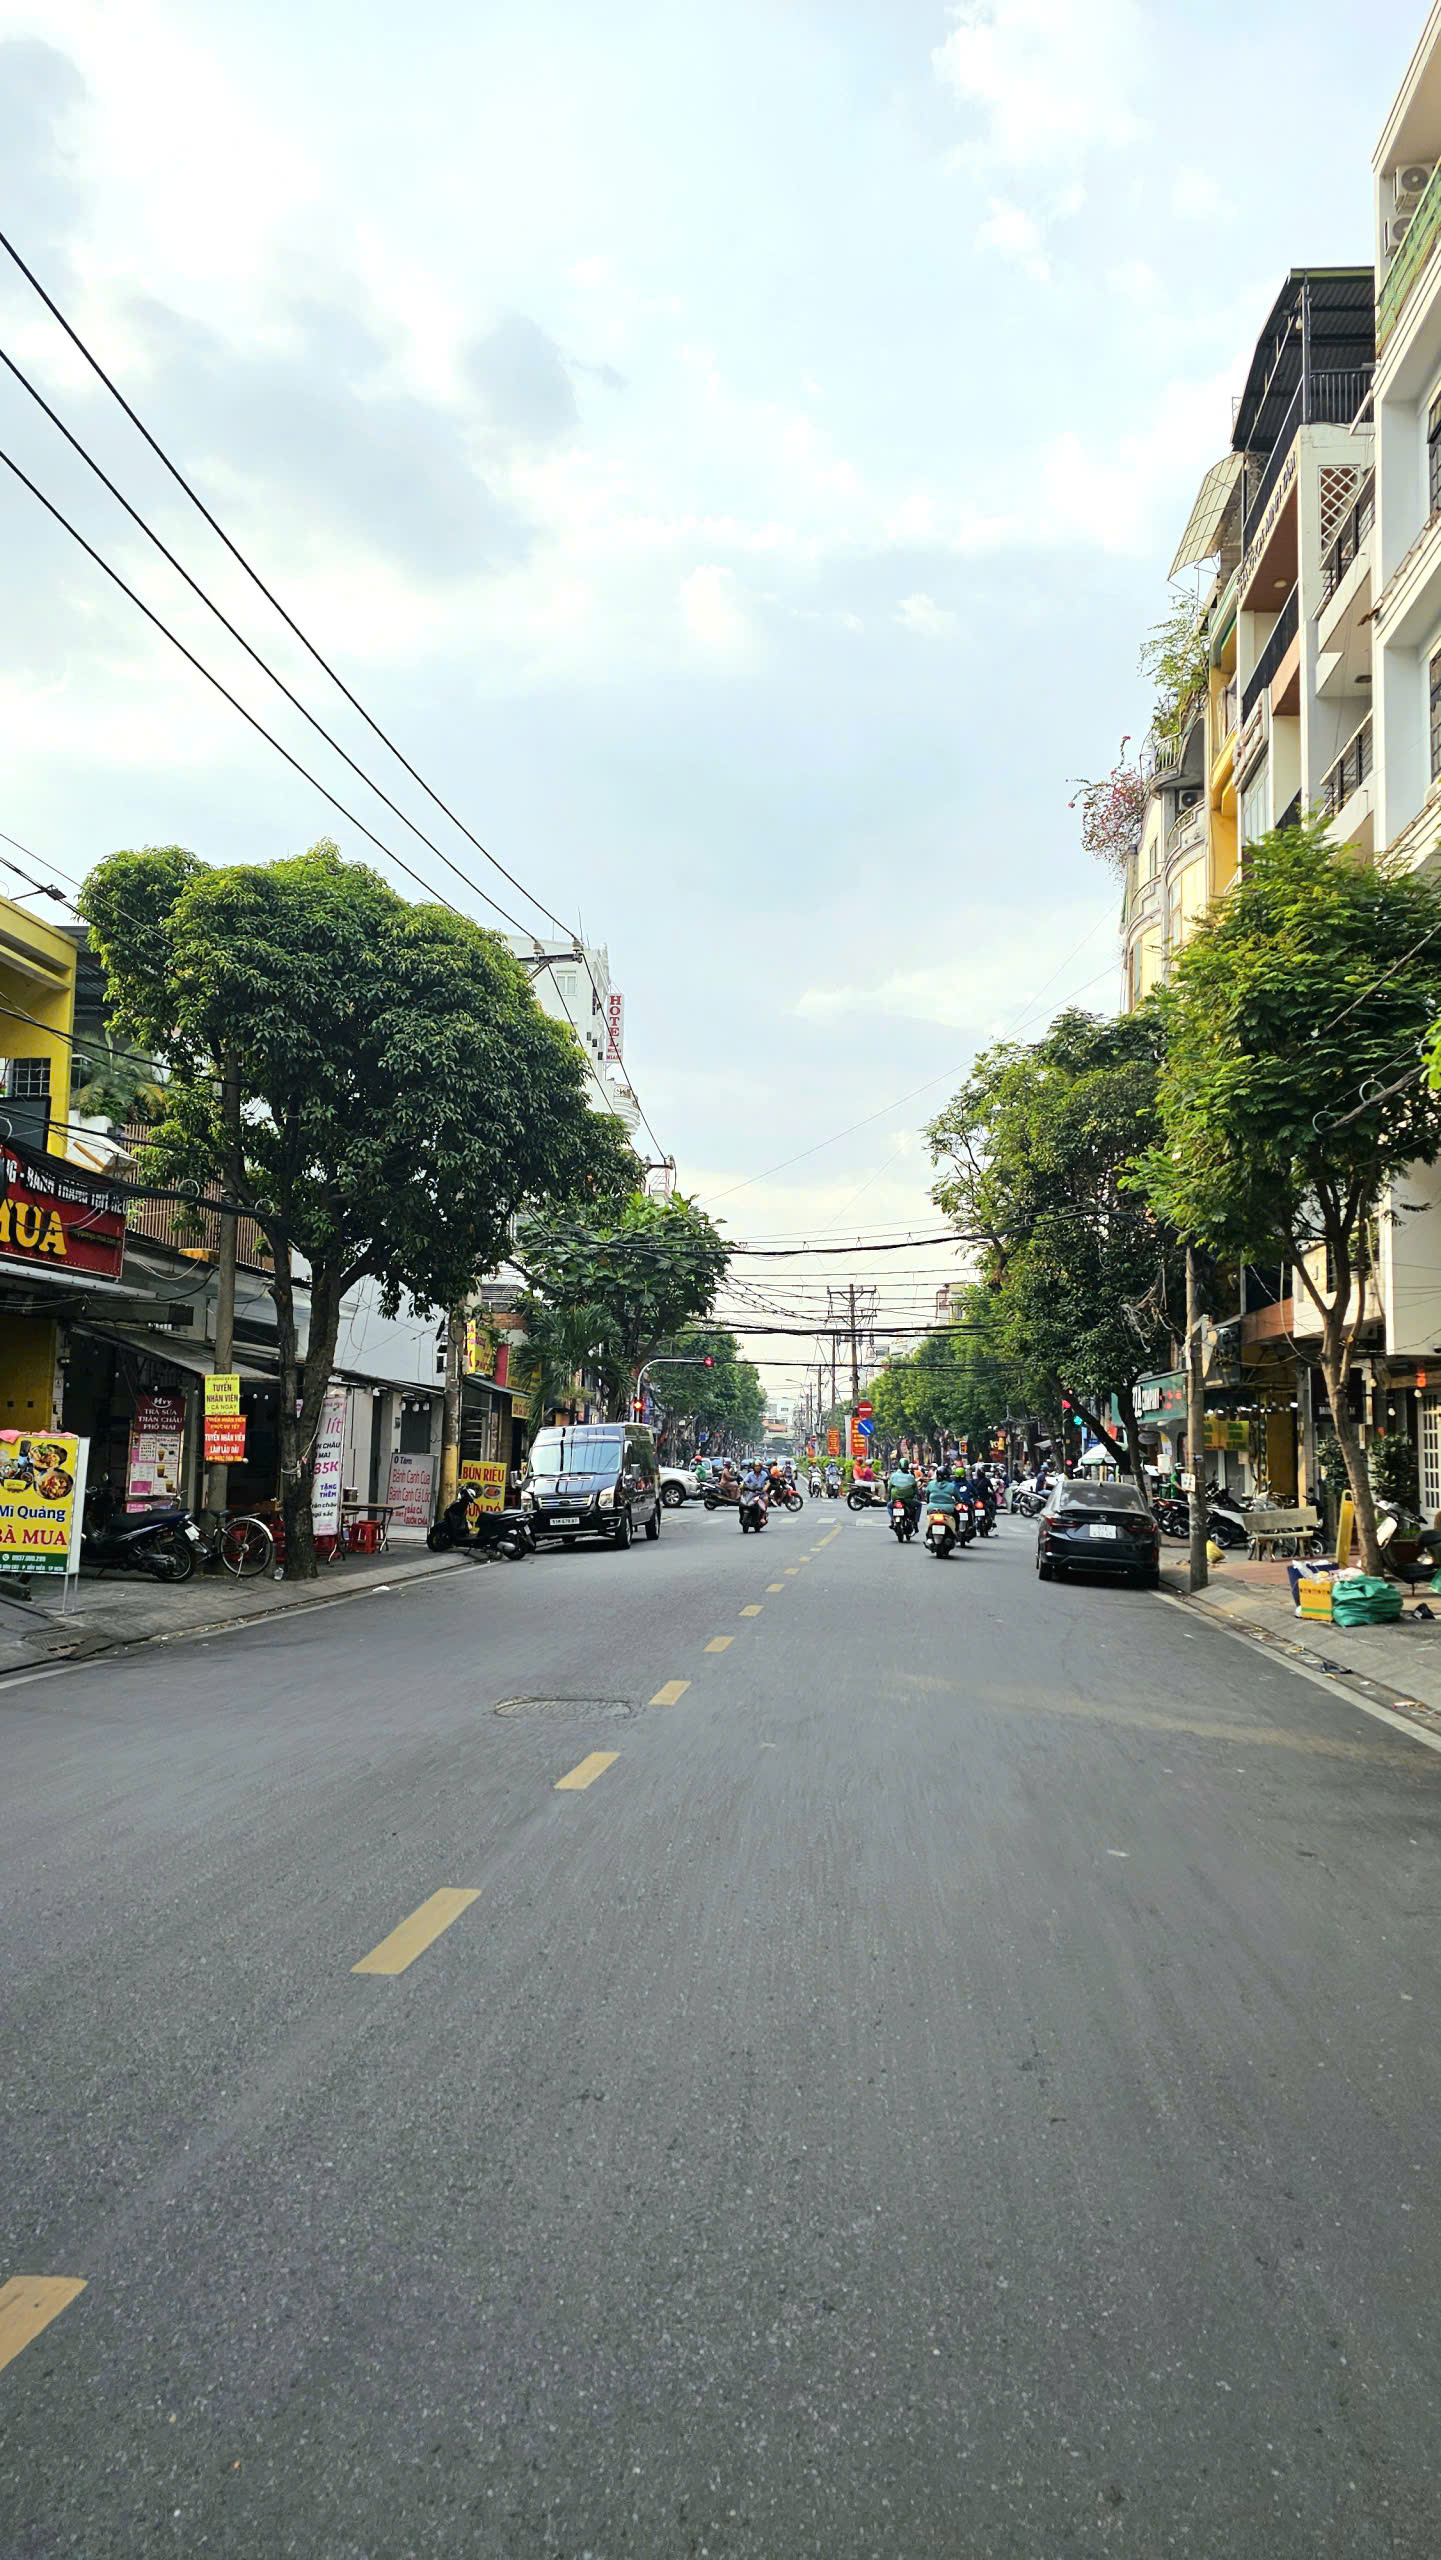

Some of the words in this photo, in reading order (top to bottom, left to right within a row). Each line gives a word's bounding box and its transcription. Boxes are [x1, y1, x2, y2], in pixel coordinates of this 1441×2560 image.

[609, 995, 621, 1047] HOTEL
[213, 1380, 232, 1392] TUYỂN
[207, 1393, 223, 1402] NHÂN
[225, 1393, 238, 1402] VIÊN
[323, 1441, 340, 1449] CHÂU
[314, 1461, 339, 1475] 35K
[462, 1464, 482, 1480] BÚN
[483, 1466, 505, 1482] RIÊU
[320, 1483, 337, 1491] TẶNG
[320, 1490, 337, 1498] THÊM
[17, 1505, 66, 1523] Quảng
[22, 1529, 68, 1546] MUA
